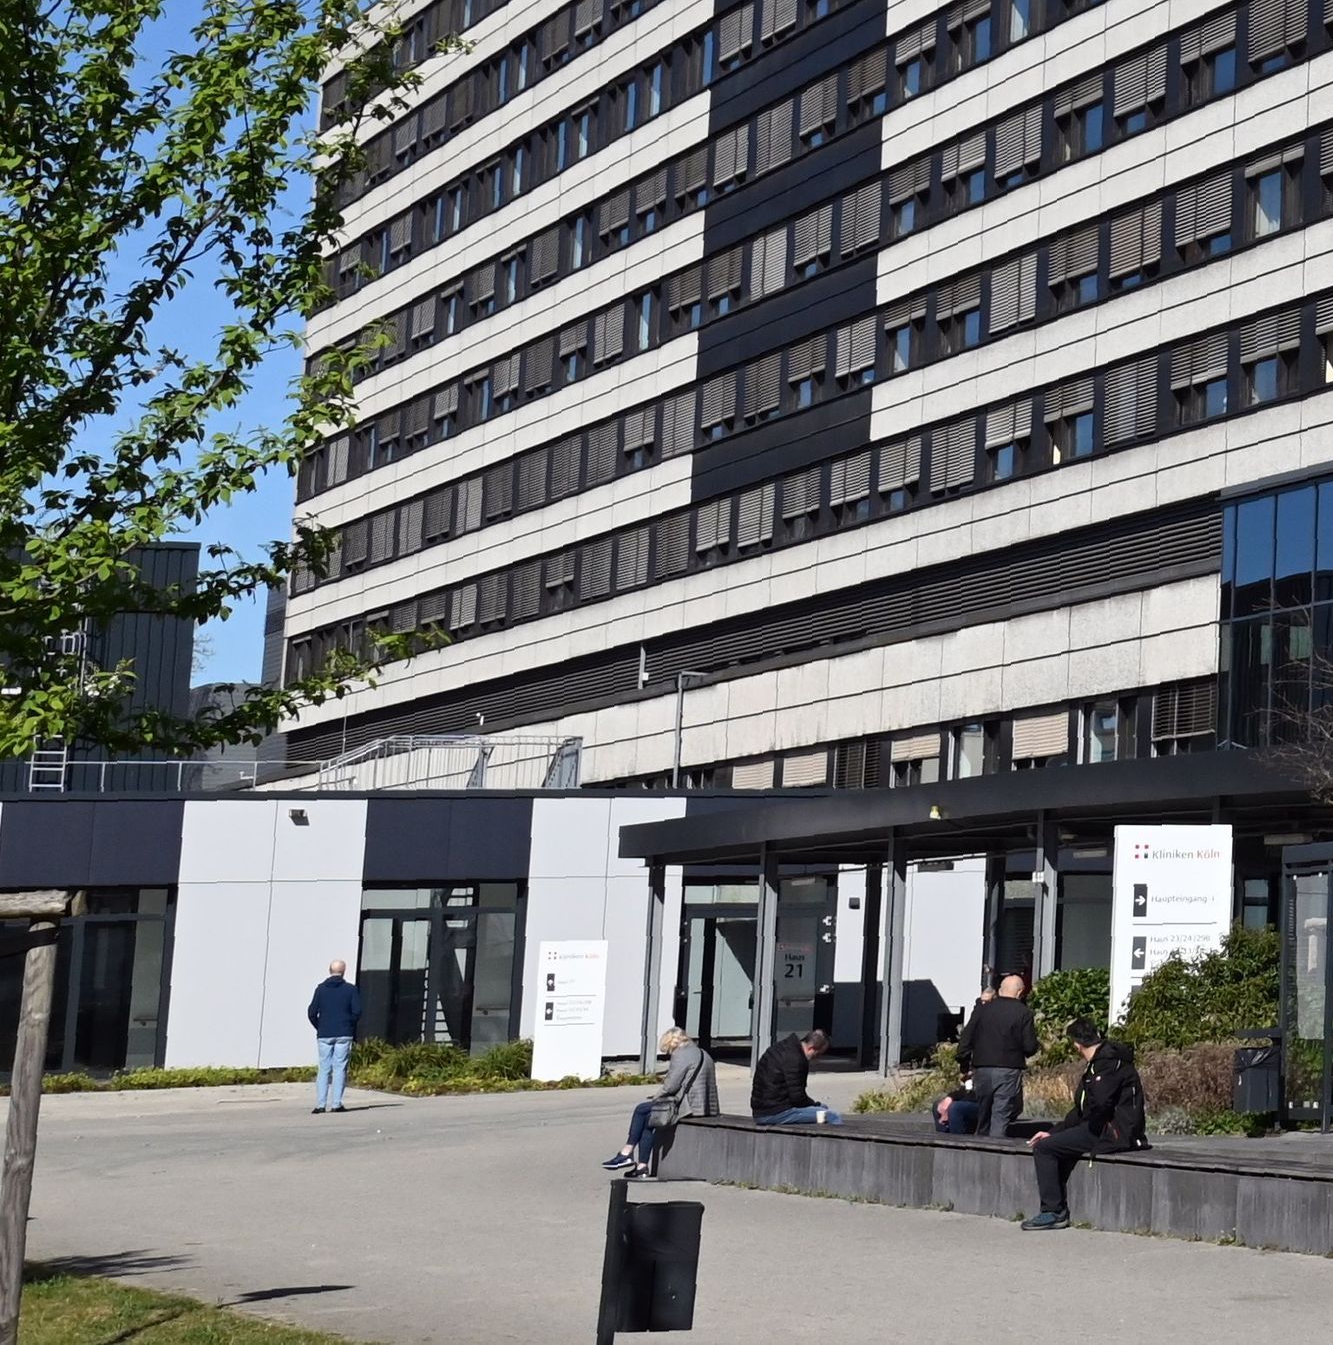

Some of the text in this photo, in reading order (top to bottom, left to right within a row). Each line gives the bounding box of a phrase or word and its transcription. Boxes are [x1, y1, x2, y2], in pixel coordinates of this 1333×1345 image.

[1152, 848, 1220, 859] Kliniken Köln
[1151, 895, 1207, 903] Haupteingang
[784, 963, 803, 978] 21
